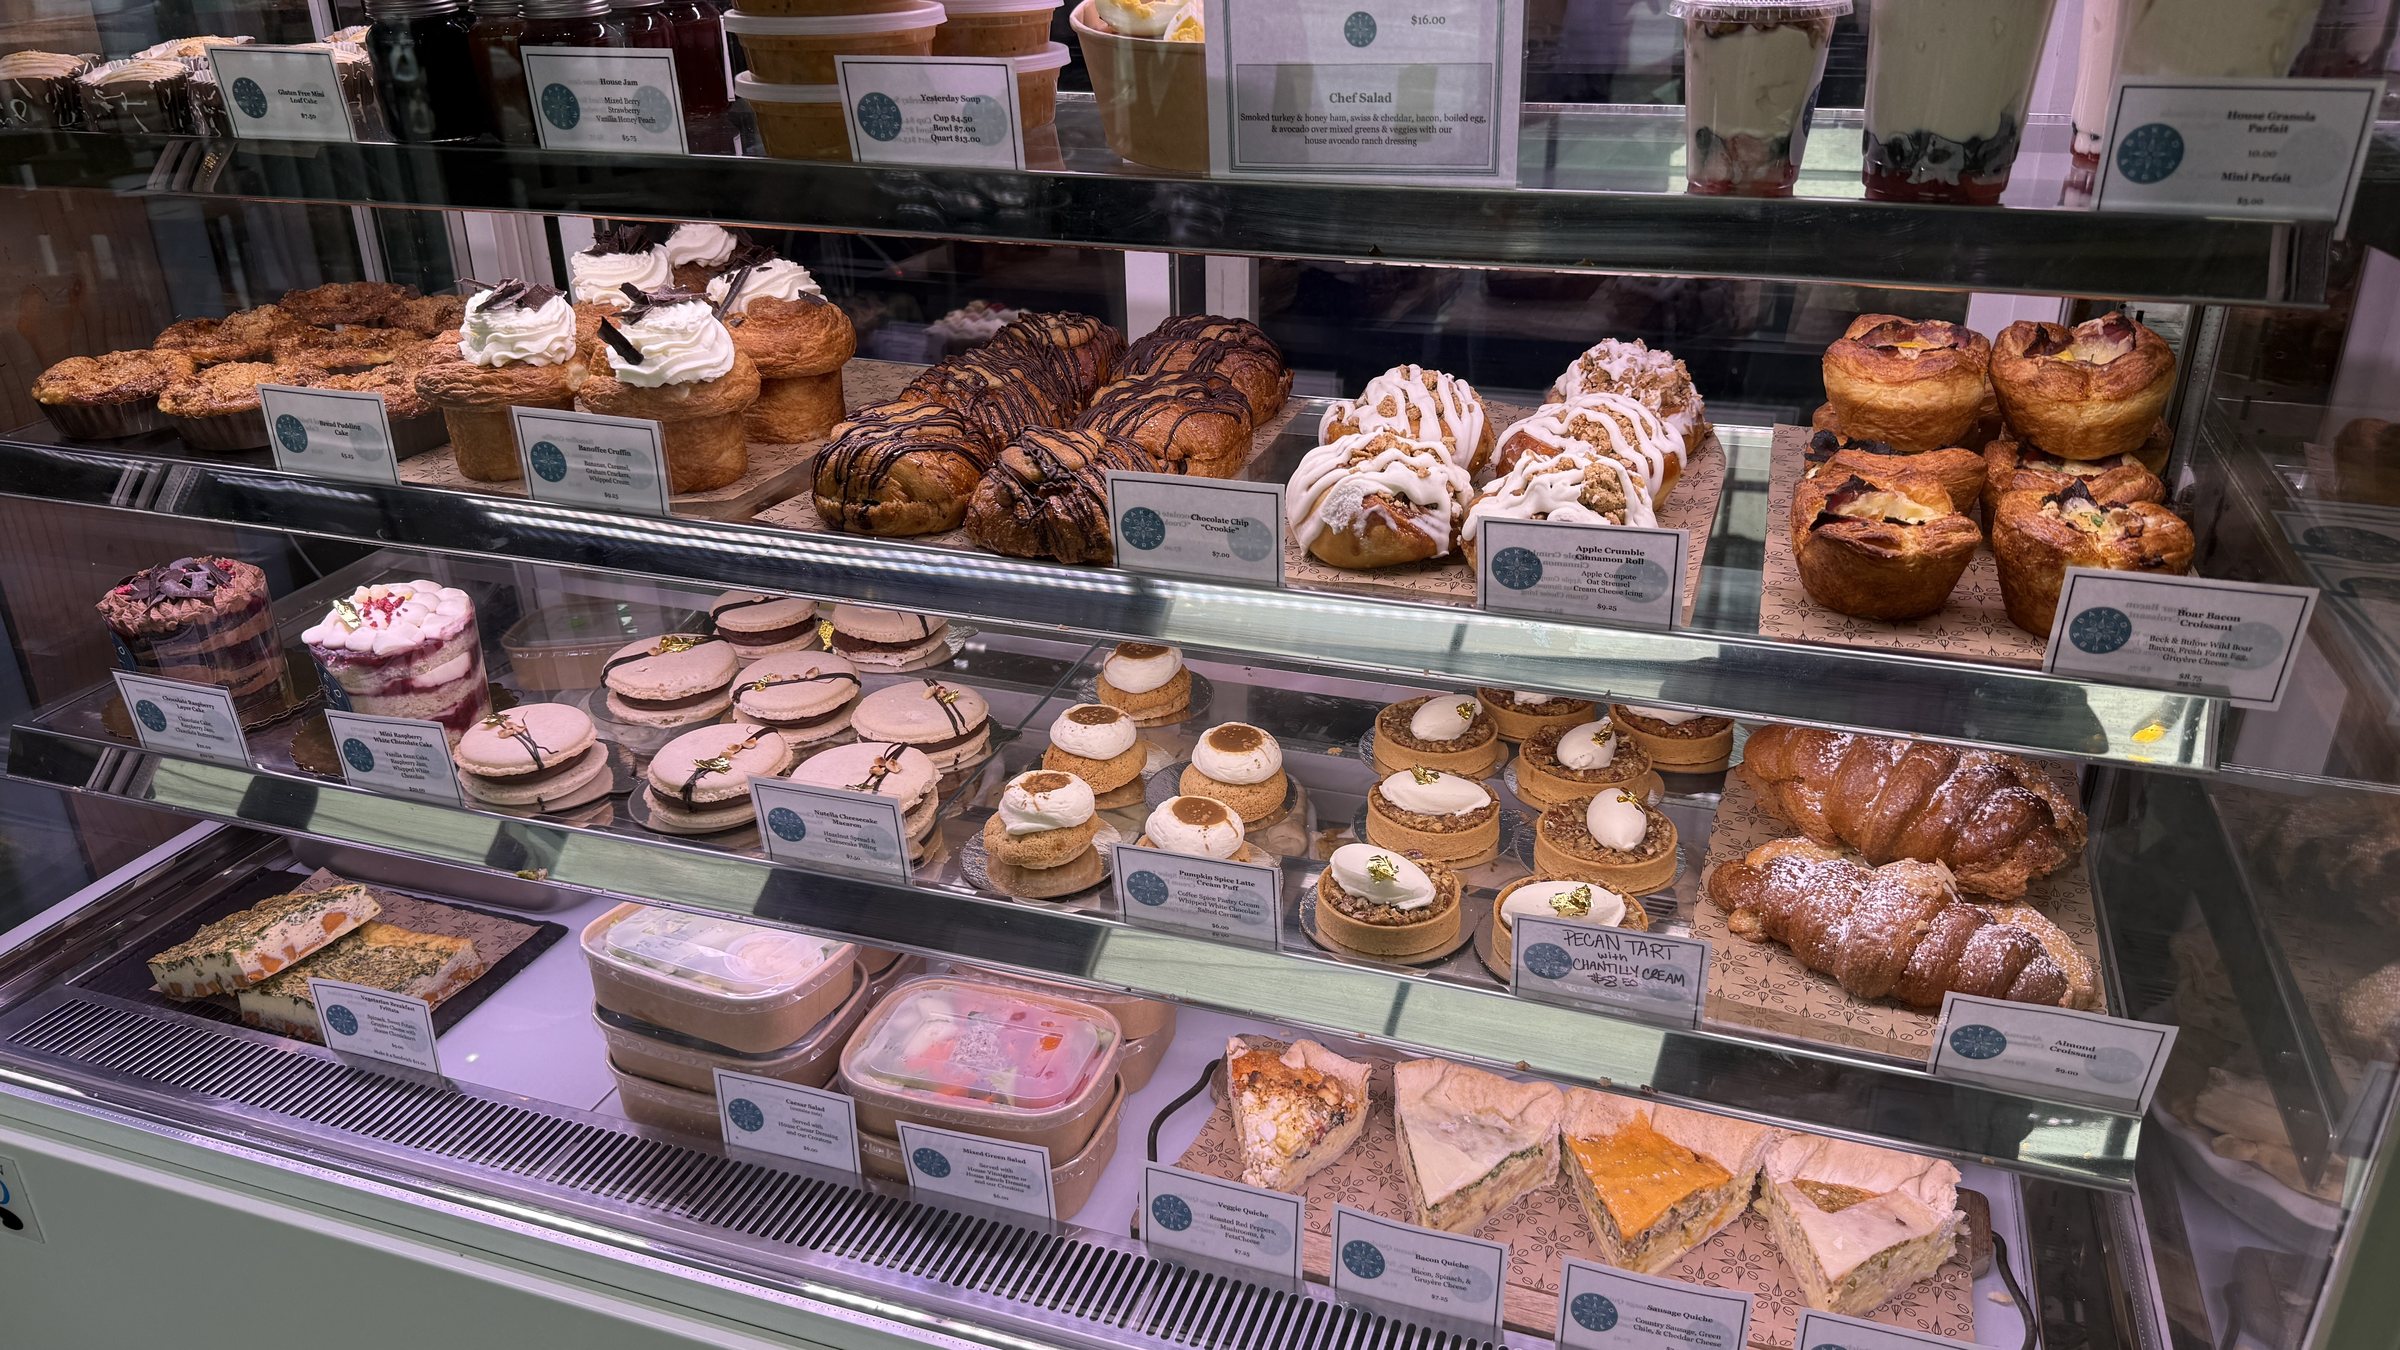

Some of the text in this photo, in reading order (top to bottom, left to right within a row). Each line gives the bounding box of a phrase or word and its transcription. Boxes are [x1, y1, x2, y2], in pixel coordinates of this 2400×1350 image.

[1410, 15, 1446, 26] $16.00
[624, 98, 640, 106] Berry
[920, 94, 981, 104] Yesterday Soup
[1328, 92, 1392, 104] Chef Salad
[608, 106, 640, 114] Strawberry
[618, 116, 638, 124] Honey
[933, 114, 973, 124] Cup $4.50
[1240, 113, 1486, 124] Smoked turkey honey ham, swiss cheddar, bacon, boiled egg,
[2228, 110, 2316, 122] House Granola
[933, 124, 976, 133] Bowl $7.00
[1279, 125, 1310, 134] avocado
[1329, 125, 1353, 134] mixed
[1354, 126, 1380, 136] greens
[1390, 126, 1418, 136] veggies
[1419, 125, 1437, 134] with
[2248, 123, 2289, 134] Parfait
[930, 134, 982, 145] Quart $13.00
[1304, 136, 1417, 147] house avocado ranch dressing
[2248, 150, 2278, 158] 10.00
[2220, 172, 2291, 184] Mini Parfait
[319, 420, 362, 431] Bread Pudding
[578, 444, 632, 456] Banoffee Cruffin
[588, 475, 612, 484] Whipped
[1190, 514, 1250, 528] Chocolate Chip
[1212, 550, 1230, 558] $7.00
[1576, 545, 1645, 556] Apple Crumble
[1576, 554, 1623, 564] Cinnamon
[1581, 570, 1637, 582] Apple Compote
[1598, 588, 1624, 596] Cheese
[1624, 590, 1643, 599] Icing
[1596, 603, 1617, 612] $9.25
[2176, 608, 2241, 622] Boar Bacon
[2179, 619, 2232, 631] Croissant
[2149, 634, 2169, 644] Beck
[2210, 640, 2230, 650] Wild
[2232, 643, 2253, 652] Boar
[2148, 643, 2228, 658] Bacon, Fresh Farm
[2198, 657, 2230, 666] Cheese
[2178, 672, 2202, 681] $8.75
[814, 809, 878, 824] Nutella Cheesecake
[832, 819, 862, 828] Macaron
[1179, 870, 1256, 887] Pumpkin Spice Latte
[1196, 879, 1221, 889] Cream
[1177, 890, 1260, 909] Coffee Spice Pastry Cream
[1178, 897, 1207, 907] Whipped
[1228, 905, 1261, 916] Chocolate
[1197, 907, 1217, 915] Salted
[1562, 929, 1680, 960] PECAN TART
[1597, 952, 1628, 962] with
[1572, 958, 1685, 988] CHANTILLY CREAM
[2055, 1040, 2096, 1052] Almond
[2049, 1045, 2097, 1060] Croissant
[2055, 1067, 2078, 1076] $9.00
[963, 1148, 1026, 1164] Mixed Green Salad
[1218, 1201, 1269, 1218] Veggie Quiche
[1209, 1213, 1234, 1225] Roasted
[1249, 1223, 1277, 1236] Peppers,
[1220, 1224, 1259, 1238] Mushrooms,
[1415, 1253, 1470, 1269] Bacon Quiche
[1411, 1267, 1464, 1284] Bacon, Spinach,
[1443, 1281, 1468, 1291] Cheese
[1646, 1304, 1713, 1323] Sausage Quiche
[1635, 1316, 1721, 1340] Country Sausage, Green
[1633, 1324, 1722, 1348] Chile, Cheddar Cheese
